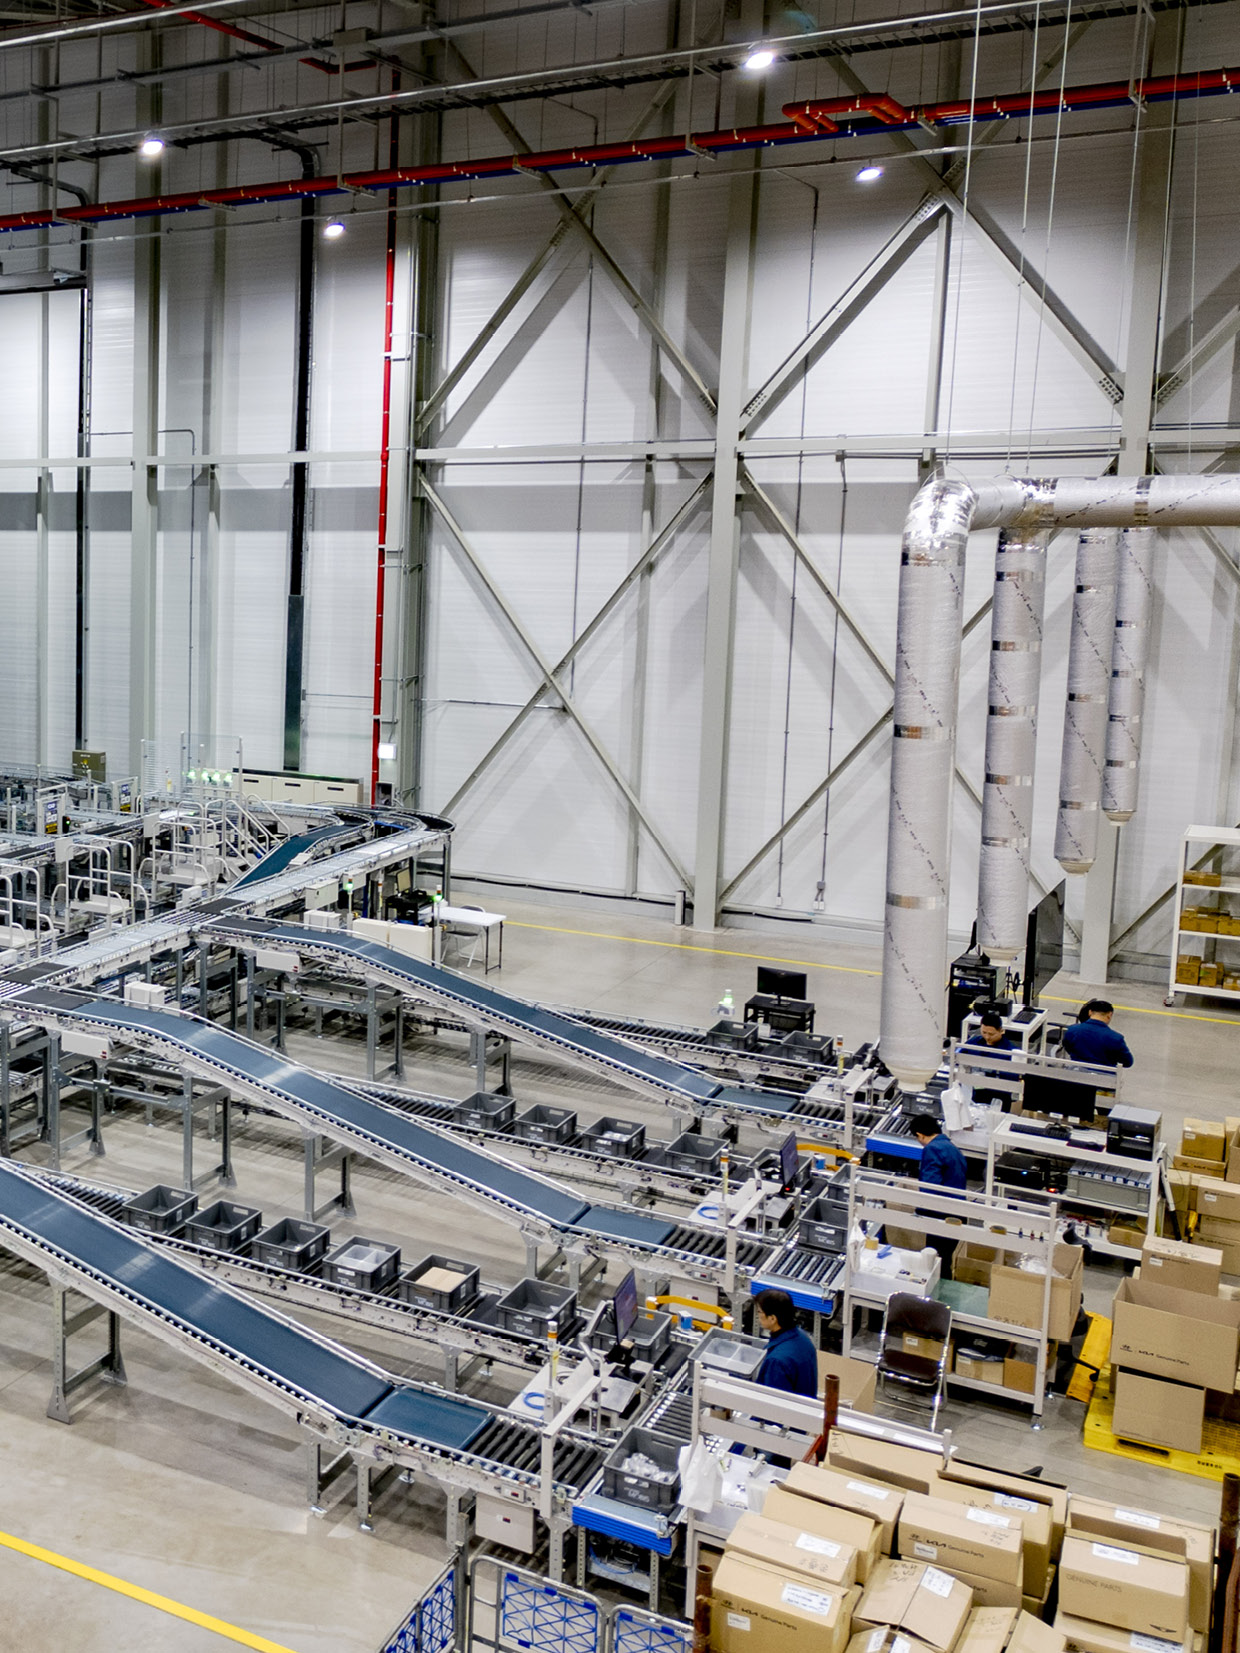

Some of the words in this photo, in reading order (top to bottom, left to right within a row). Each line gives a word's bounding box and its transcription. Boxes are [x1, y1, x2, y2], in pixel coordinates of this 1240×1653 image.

[948, 1544, 970, 1555] Genuine
[970, 1550, 985, 1559] Parts
[1065, 1572, 1099, 1588] GENUINE
[1100, 1580, 1123, 1594] PARTS
[760, 1614, 783, 1627] Genuine
[782, 1621, 799, 1632] Parts
